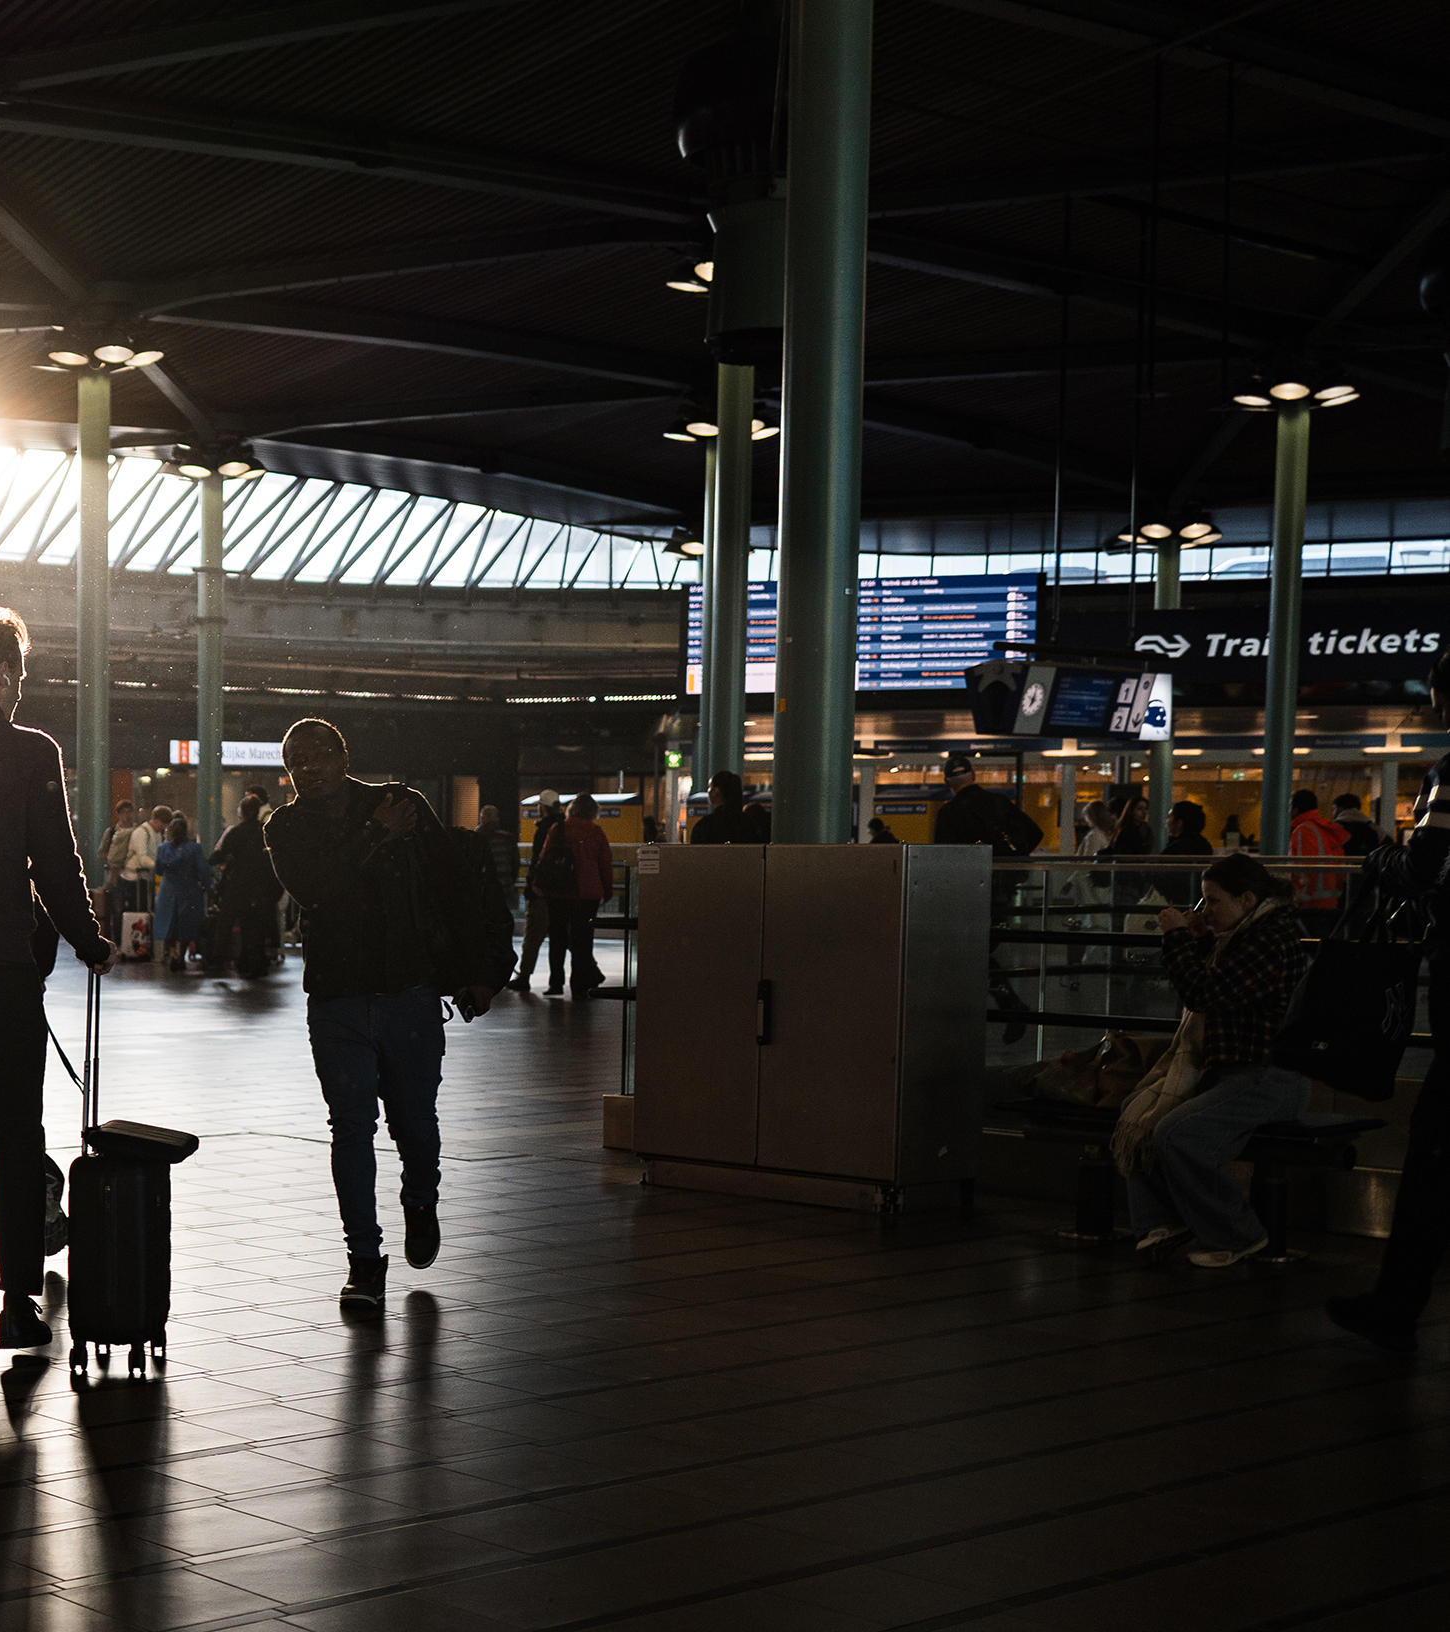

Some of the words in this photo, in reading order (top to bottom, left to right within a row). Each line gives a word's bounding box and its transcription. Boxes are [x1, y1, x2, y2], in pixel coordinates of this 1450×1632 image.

[1205, 631, 1271, 658] Trai
[1307, 628, 1441, 655] tickets
[1123, 687, 1130, 701] 1
[1114, 716, 1123, 729] 2
